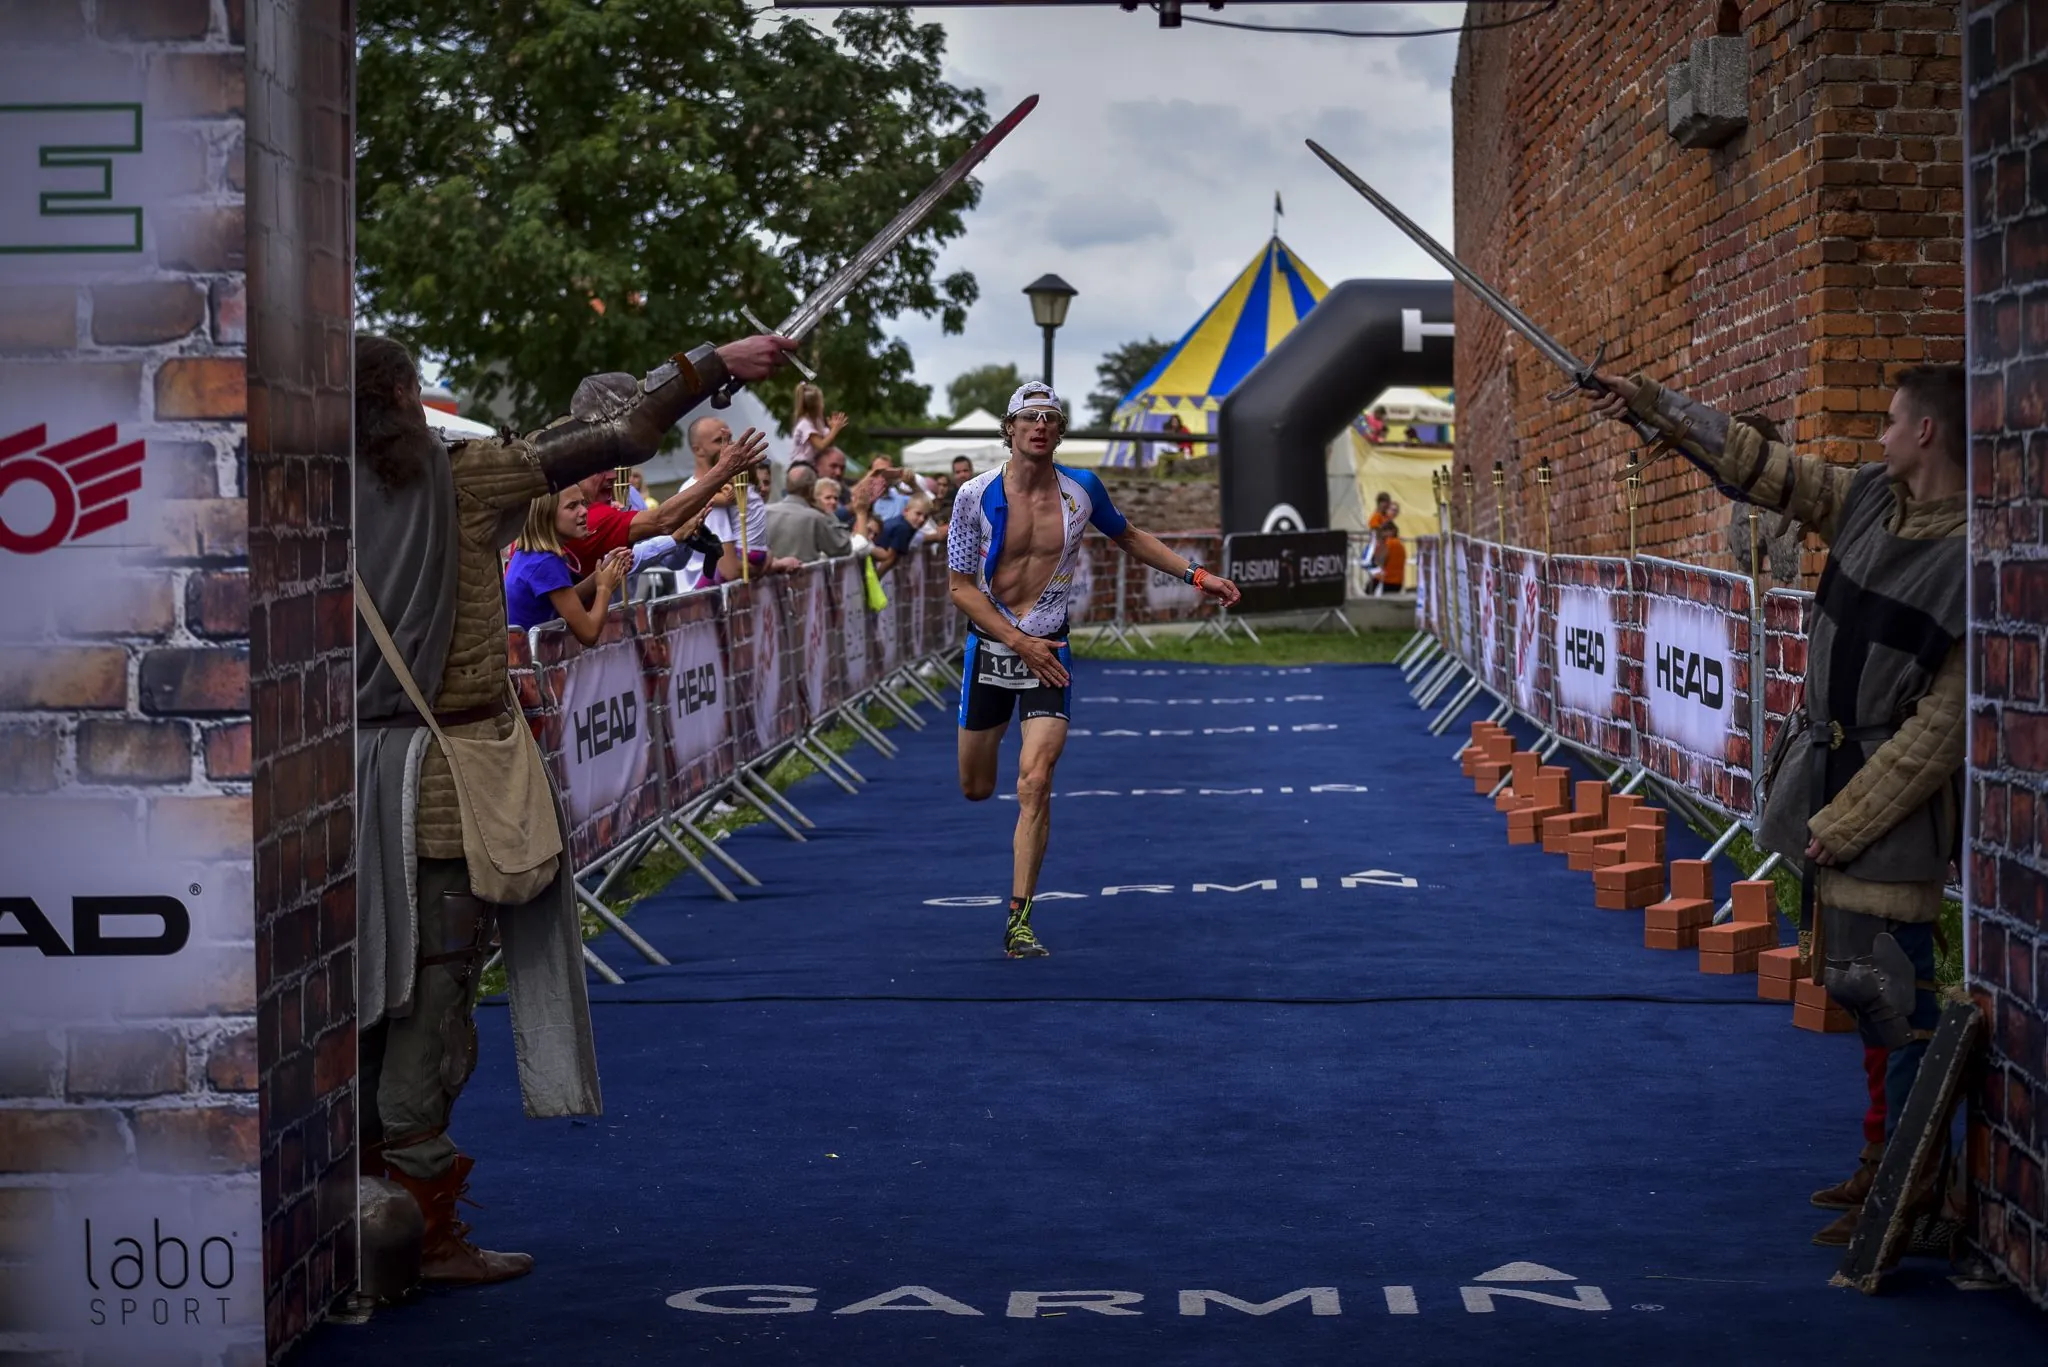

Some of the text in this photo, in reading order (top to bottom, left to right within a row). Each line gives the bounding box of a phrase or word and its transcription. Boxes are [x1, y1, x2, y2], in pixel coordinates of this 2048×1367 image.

[1231, 559, 1280, 581] FUSION
[1301, 555, 1345, 577] FUSION
[991, 656, 1029, 677] 114
[1565, 626, 1606, 676] HEAD
[1656, 641, 1724, 710] HEAD
[676, 662, 717, 719] HEAD
[573, 690, 638, 764] HEAD
[85, 1217, 234, 1291] labo
[90, 1297, 232, 1327] SPORT
[665, 1261, 1611, 1318] GARMIN
